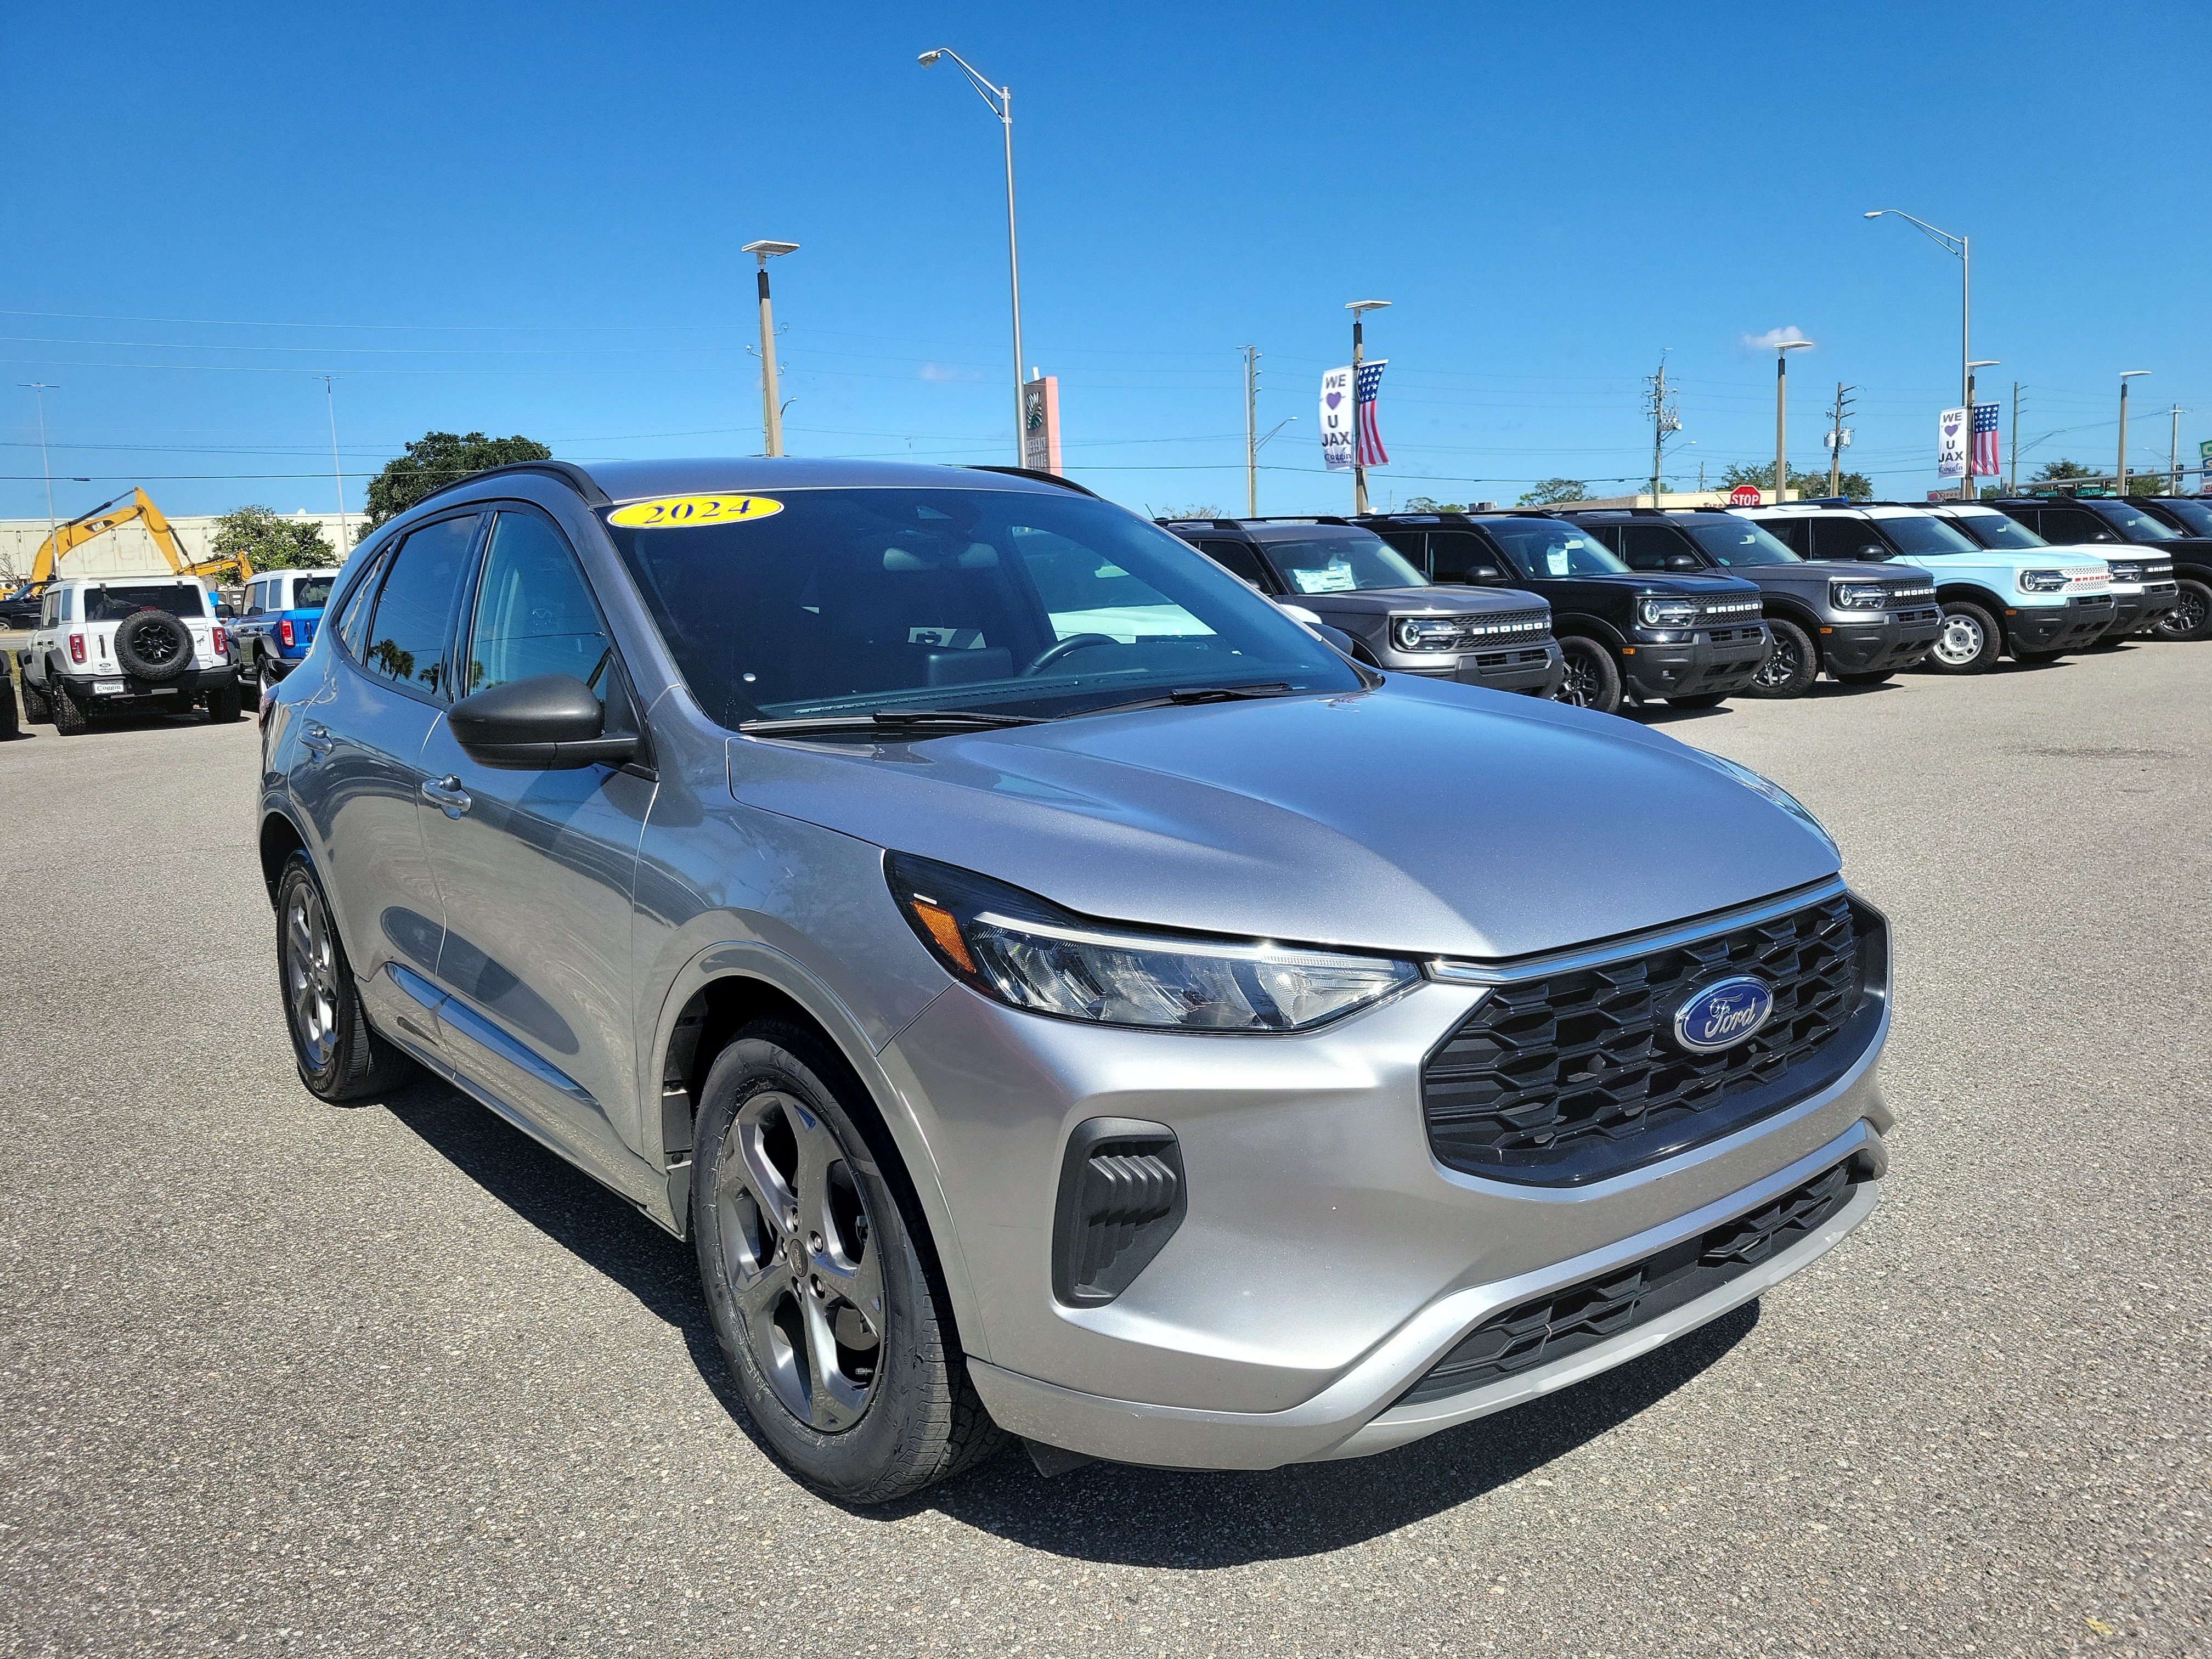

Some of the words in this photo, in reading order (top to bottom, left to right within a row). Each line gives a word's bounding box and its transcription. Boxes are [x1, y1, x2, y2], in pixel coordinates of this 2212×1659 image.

[1325, 374, 1346, 389] WE
[1328, 415, 1338, 428] U
[1943, 412, 1962, 422] WE
[1322, 431, 1352, 447] JAX
[1946, 440, 1955, 449] U
[1324, 453, 1351, 461] Coggin
[1938, 451, 1963, 462] JAX
[1939, 465, 1963, 473] Coggin
[1731, 494, 1759, 506] STOP
[642, 499, 752, 524] 2024
[1894, 588, 1934, 597] BRONCO
[1706, 603, 1759, 614] BRONCO
[1473, 622, 1543, 635] BRONCO
[1705, 993, 1756, 1039] Ford
